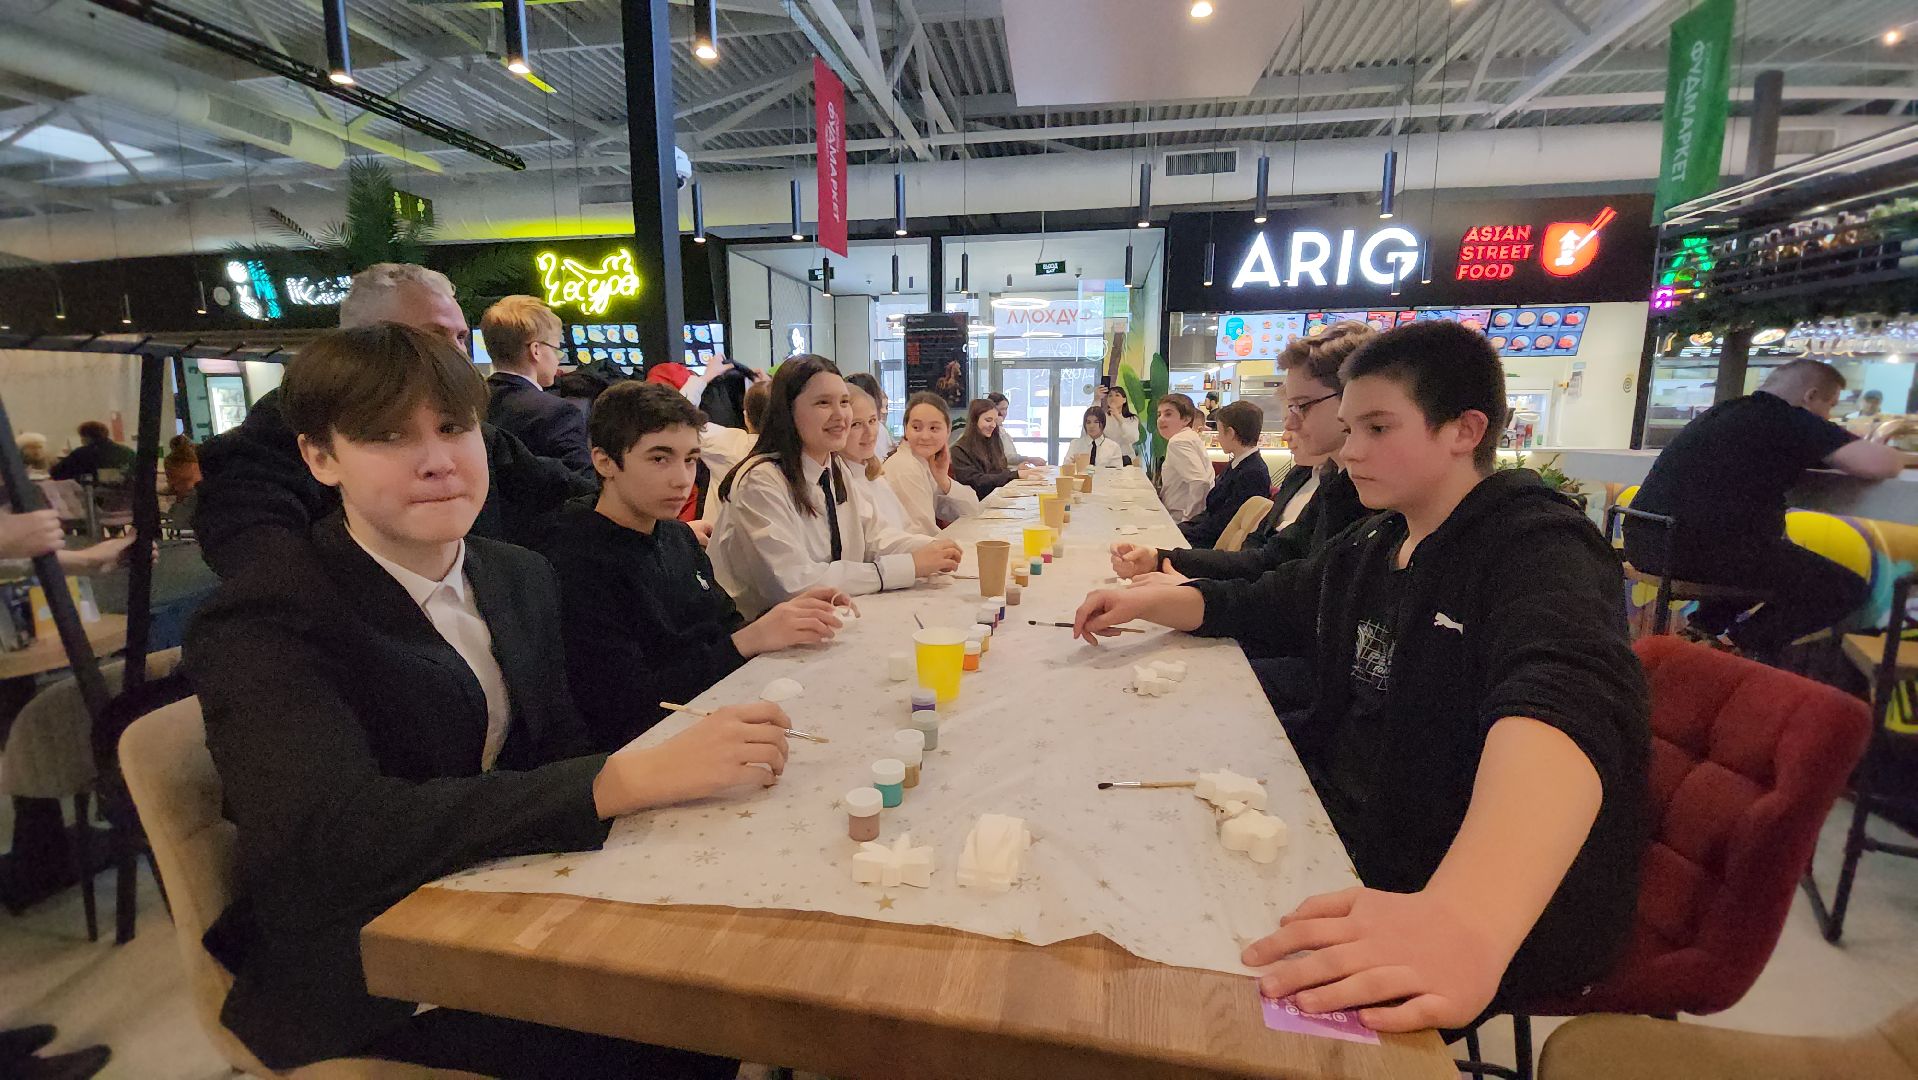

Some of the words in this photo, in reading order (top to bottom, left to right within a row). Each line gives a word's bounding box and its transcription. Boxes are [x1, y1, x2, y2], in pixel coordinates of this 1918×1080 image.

[1464, 225, 1532, 243] ASIAN
[1232, 227, 1418, 287] ARIG
[1460, 243, 1535, 262] STREET
[1456, 263, 1514, 280] FOOD
